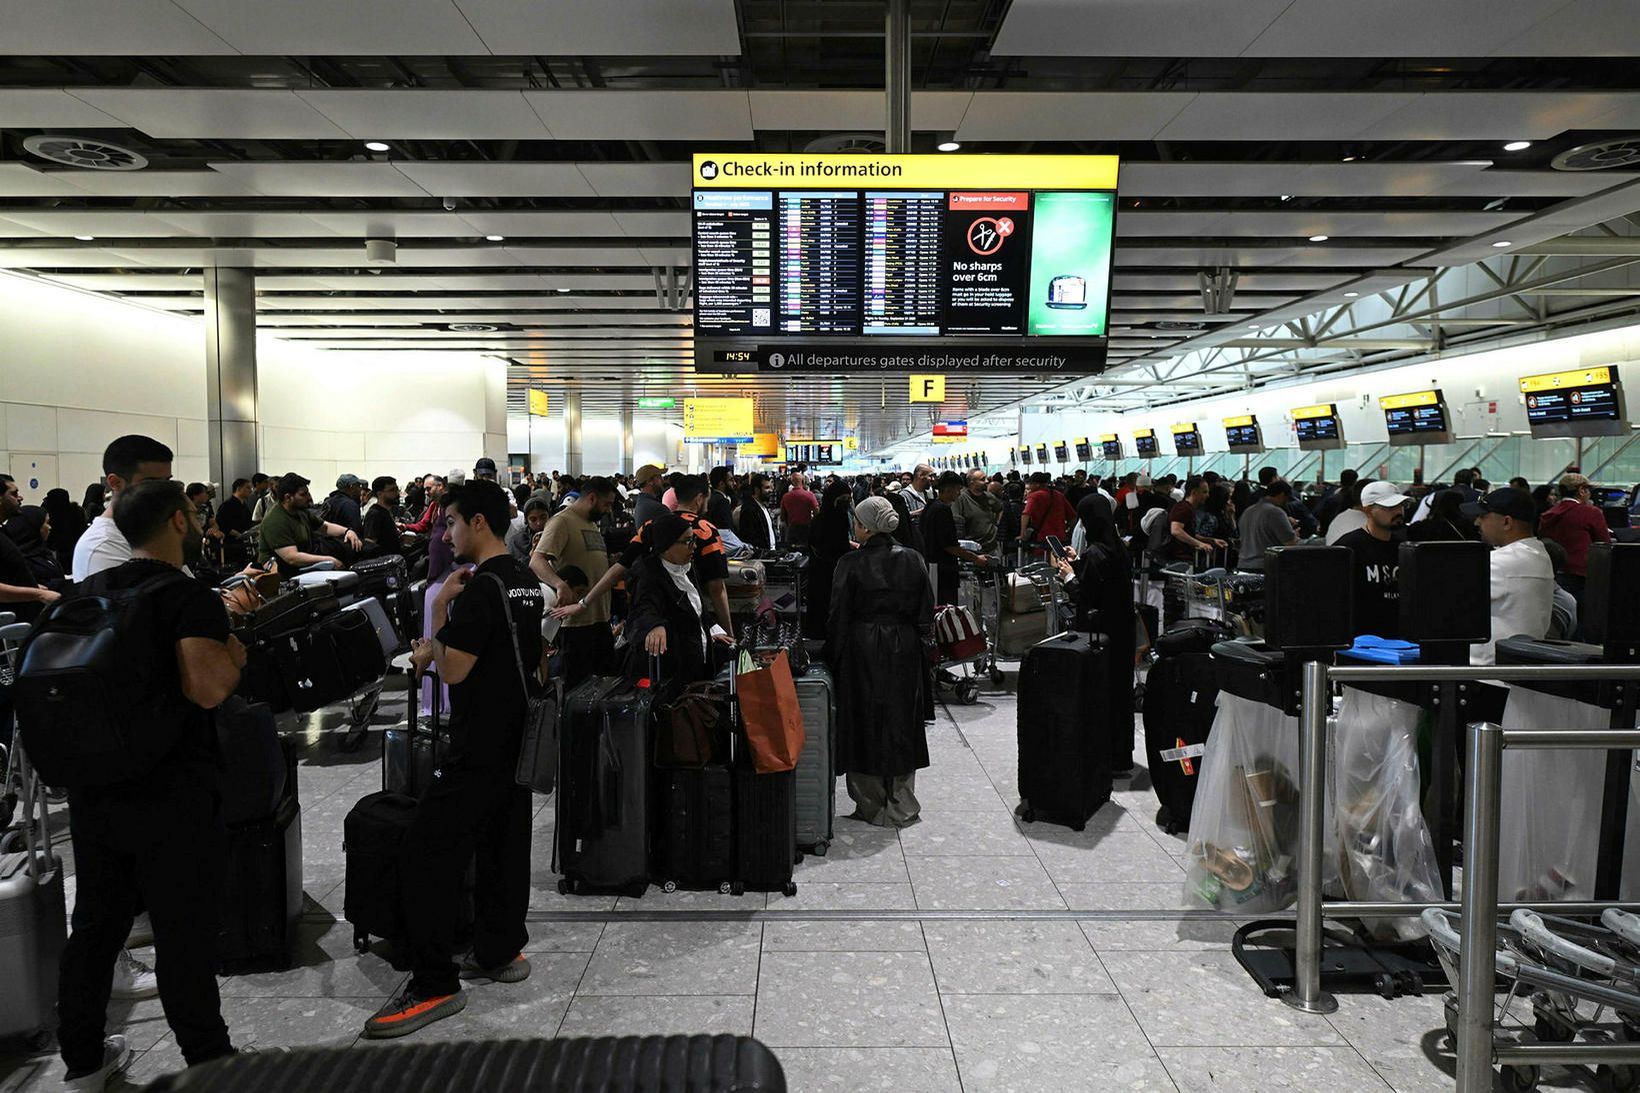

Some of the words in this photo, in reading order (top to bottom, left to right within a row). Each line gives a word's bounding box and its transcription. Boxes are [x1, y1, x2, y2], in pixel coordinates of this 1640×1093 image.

[722, 161, 795, 176] Check-in
[800, 161, 902, 176] information
[953, 262, 968, 271] No
[969, 261, 1002, 272] sharps
[977, 273, 997, 282] 6cm
[788, 354, 804, 365] All
[807, 354, 876, 367] departures
[880, 356, 914, 368] gates
[918, 355, 979, 368] displayed
[983, 354, 1012, 366] after
[1016, 355, 1066, 368] security
[924, 380, 934, 397] F
